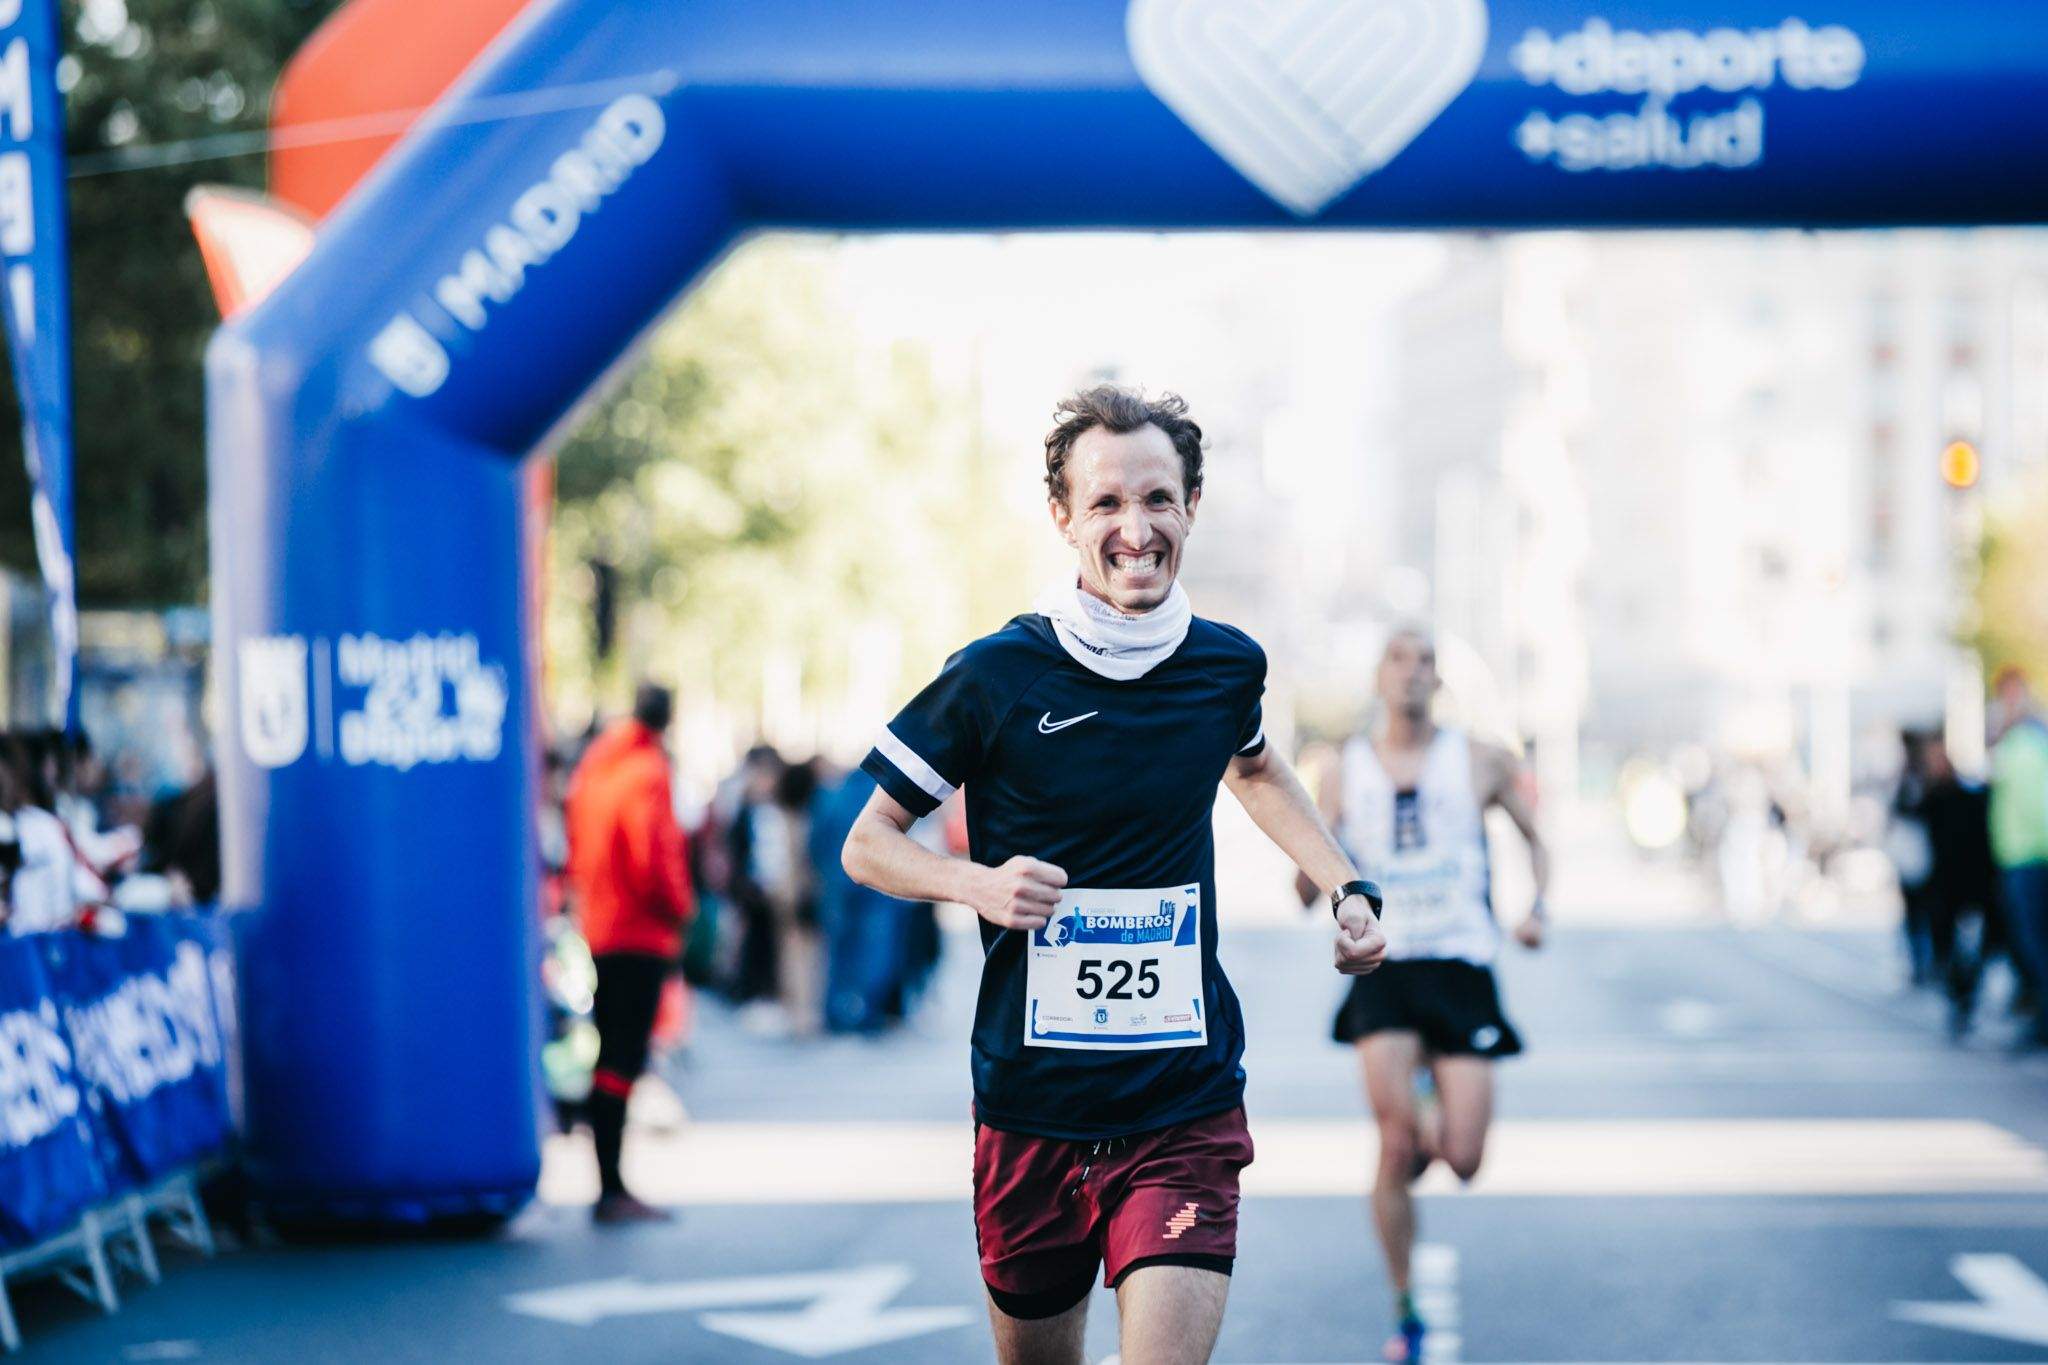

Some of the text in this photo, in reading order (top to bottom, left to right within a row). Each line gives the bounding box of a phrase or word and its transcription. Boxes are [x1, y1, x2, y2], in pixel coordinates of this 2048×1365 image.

[436, 93, 666, 330] MADRID
[1086, 915, 1172, 929] BOMBEROS
[1121, 927, 1172, 942] de MADRID
[1076, 958, 1160, 1000] 525
